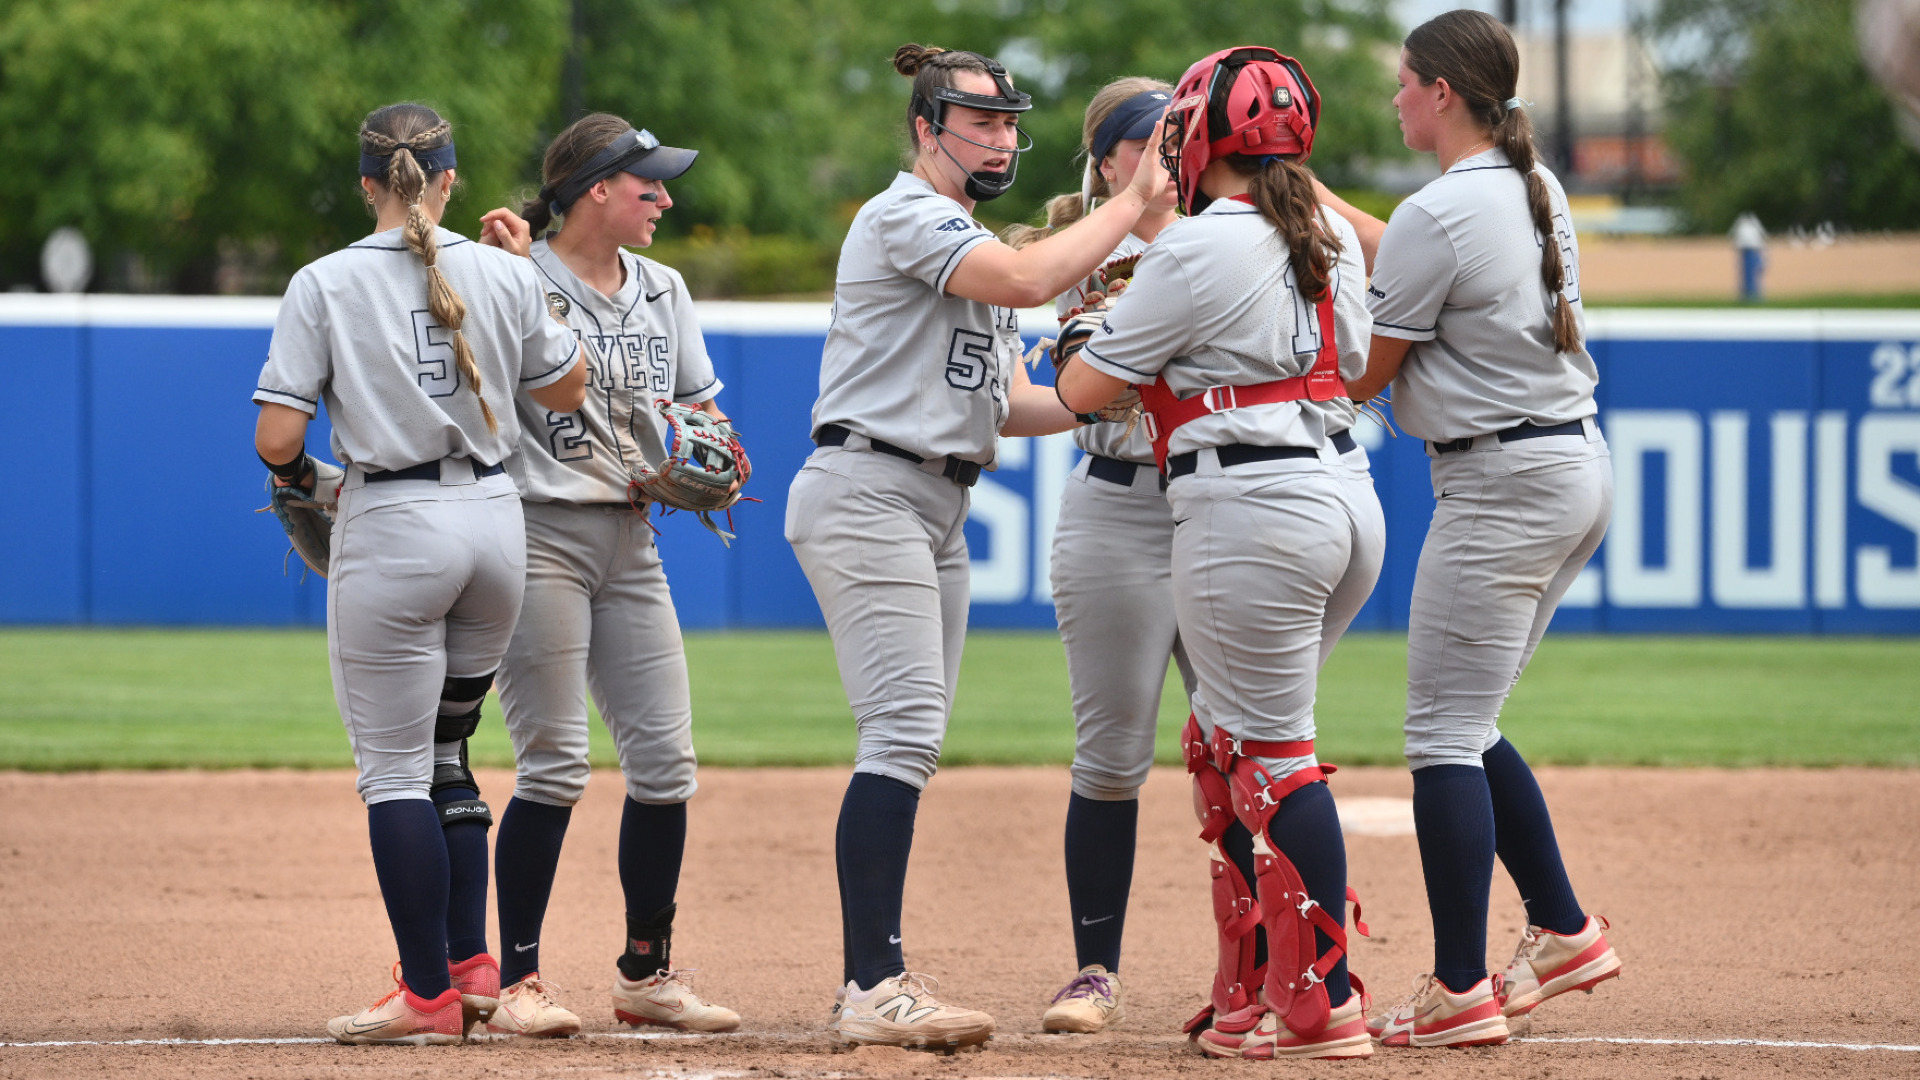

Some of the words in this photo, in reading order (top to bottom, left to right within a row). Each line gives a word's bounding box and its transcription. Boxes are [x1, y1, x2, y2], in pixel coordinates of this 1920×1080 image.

[411, 309, 460, 398] 5
[546, 409, 594, 462] 2
[1556, 412, 1920, 606] OUIS
